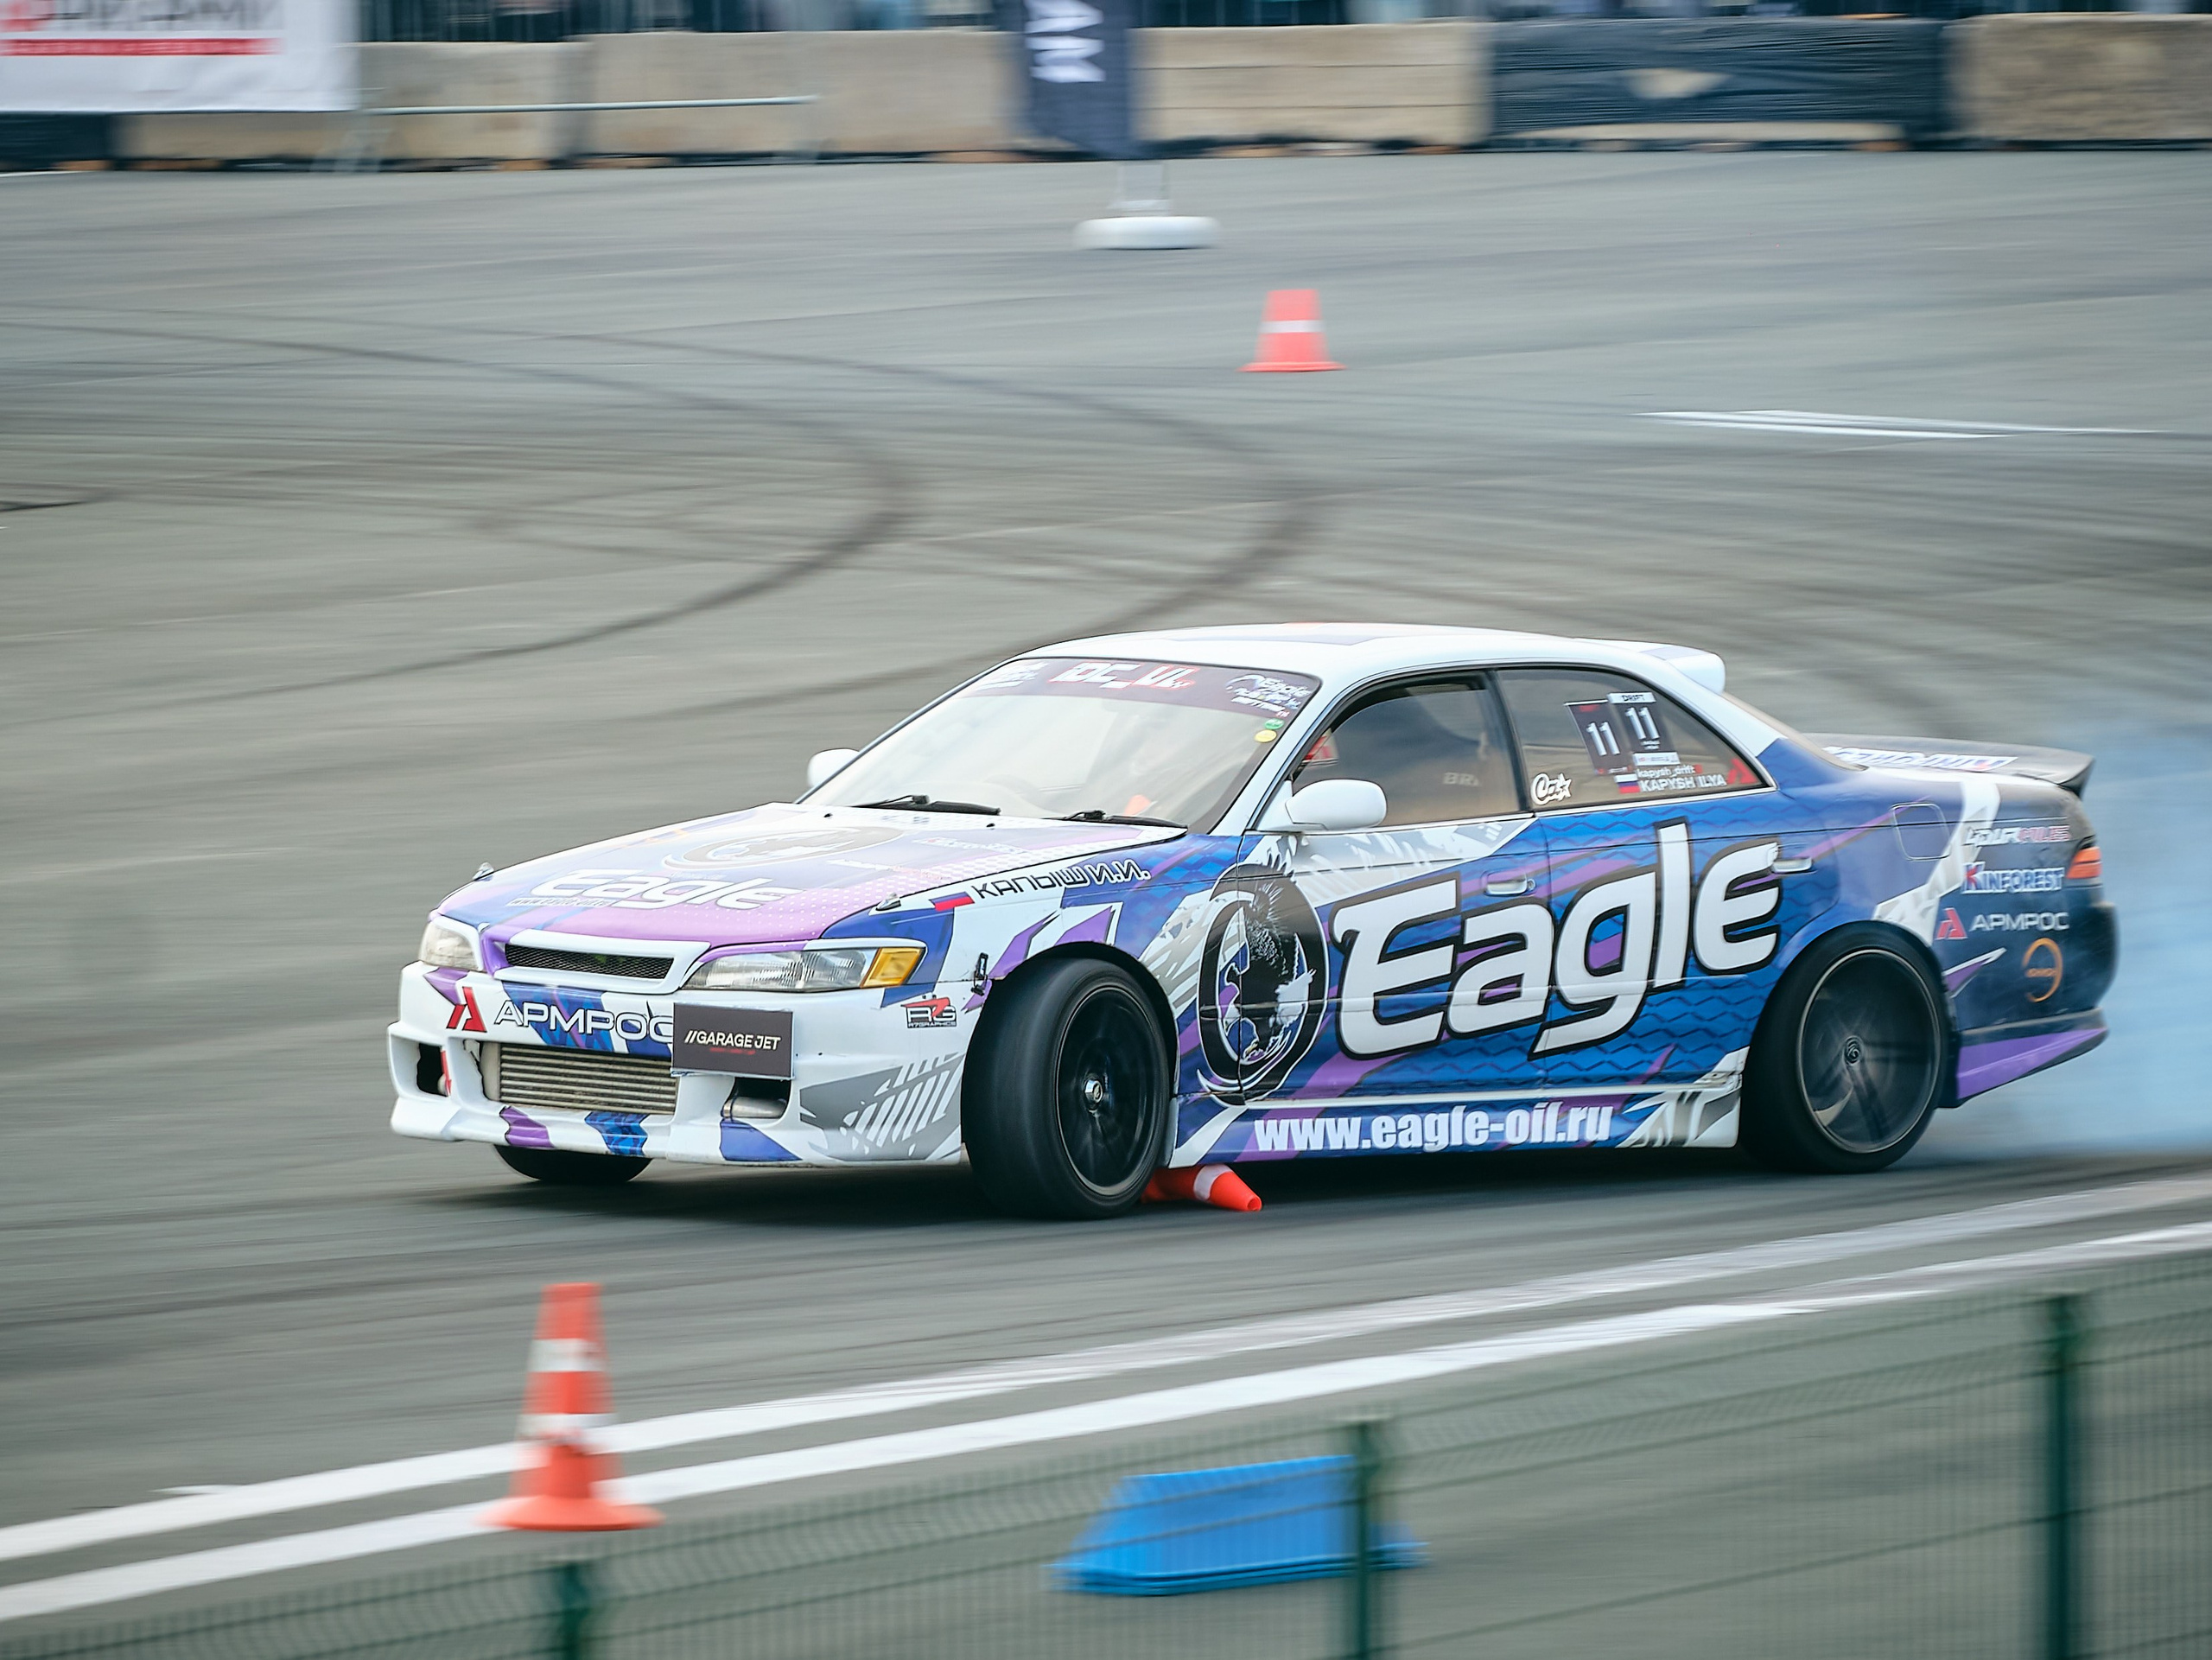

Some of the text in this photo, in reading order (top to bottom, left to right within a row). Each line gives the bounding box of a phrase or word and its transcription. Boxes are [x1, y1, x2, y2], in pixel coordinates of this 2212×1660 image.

[1586, 722, 1620, 756] 11
[1625, 707, 1660, 740] 11
[1640, 774, 1727, 792] KAPYSH ILYA
[530, 868, 807, 909] Eagle
[1961, 862, 2065, 894] KINFOREST
[1332, 818, 1780, 1059] Eagle
[754, 1035, 781, 1051] JET
[1254, 1102, 1613, 1153] www.eagle-oil.ru
